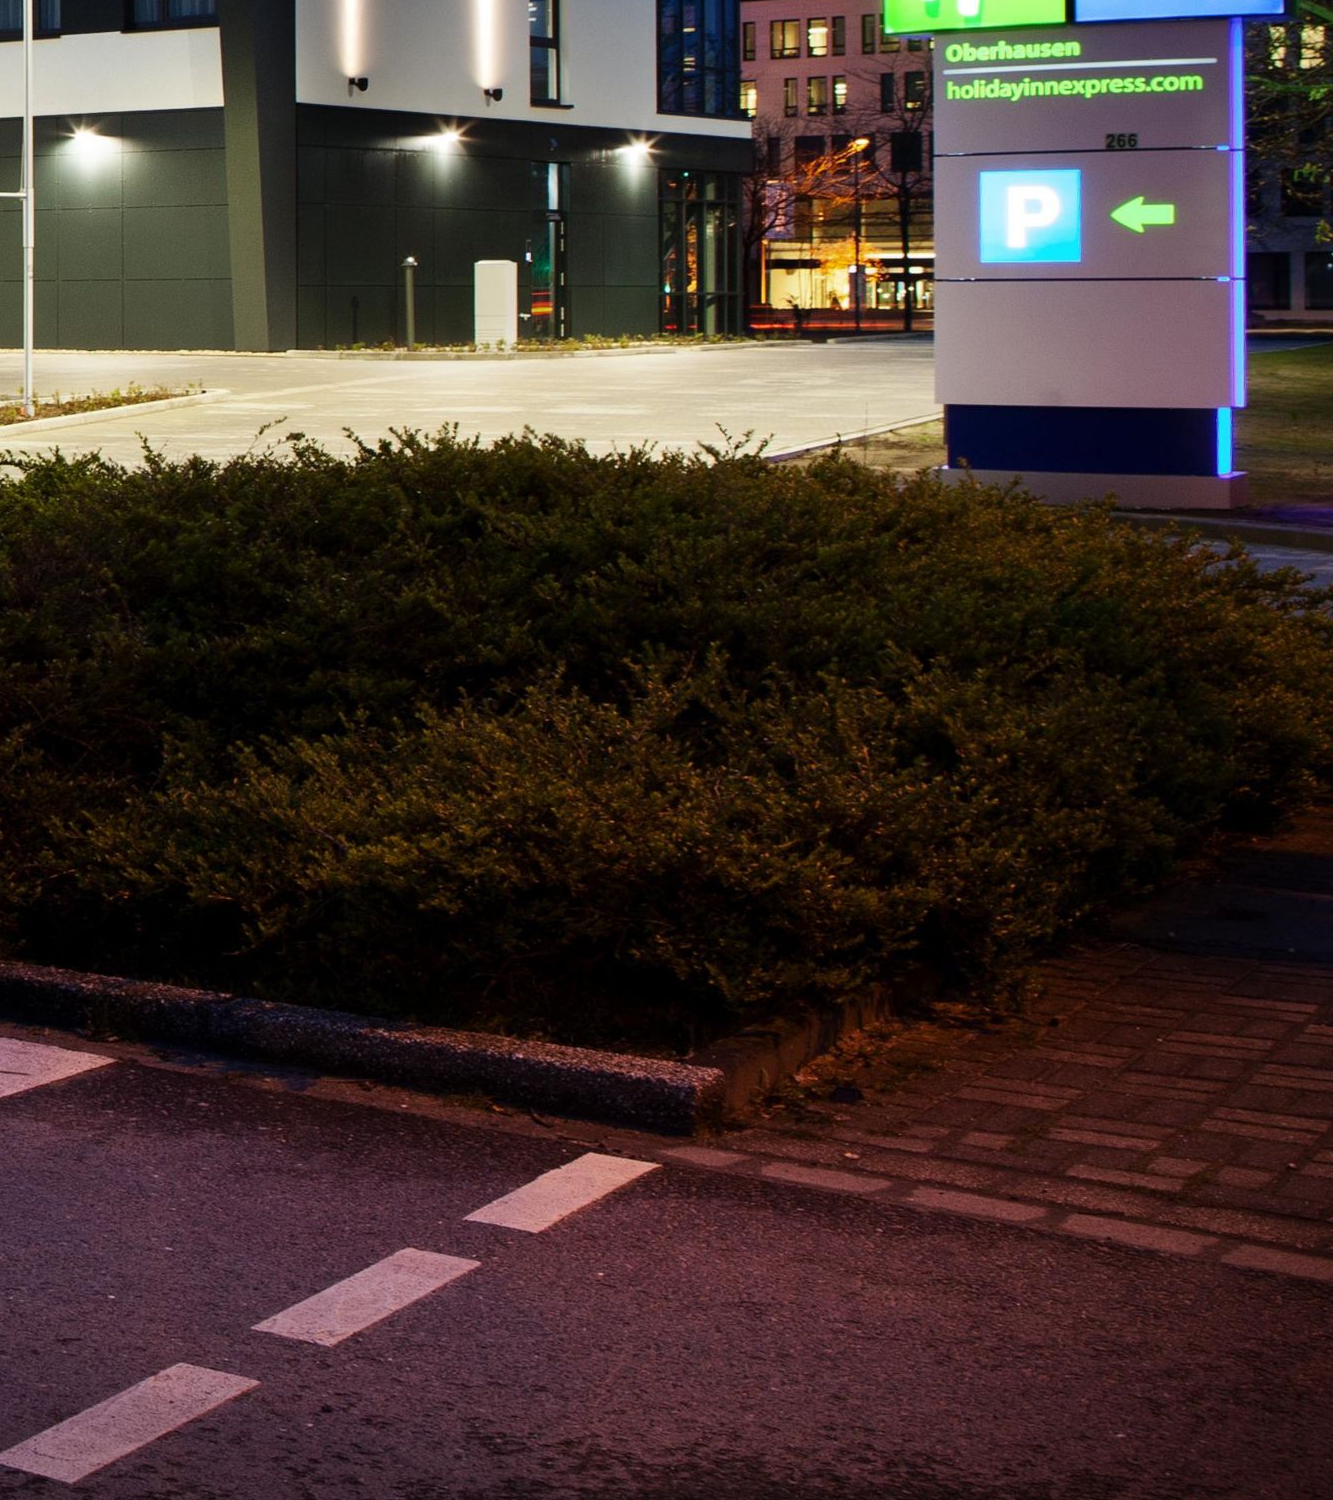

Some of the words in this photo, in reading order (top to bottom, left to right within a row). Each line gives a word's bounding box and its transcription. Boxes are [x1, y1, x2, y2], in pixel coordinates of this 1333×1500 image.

[945, 40, 1081, 62] Oberhausen
[946, 74, 1204, 102] holidayinnexpress.com
[1105, 132, 1138, 149] 266
[1004, 185, 1061, 249] P
